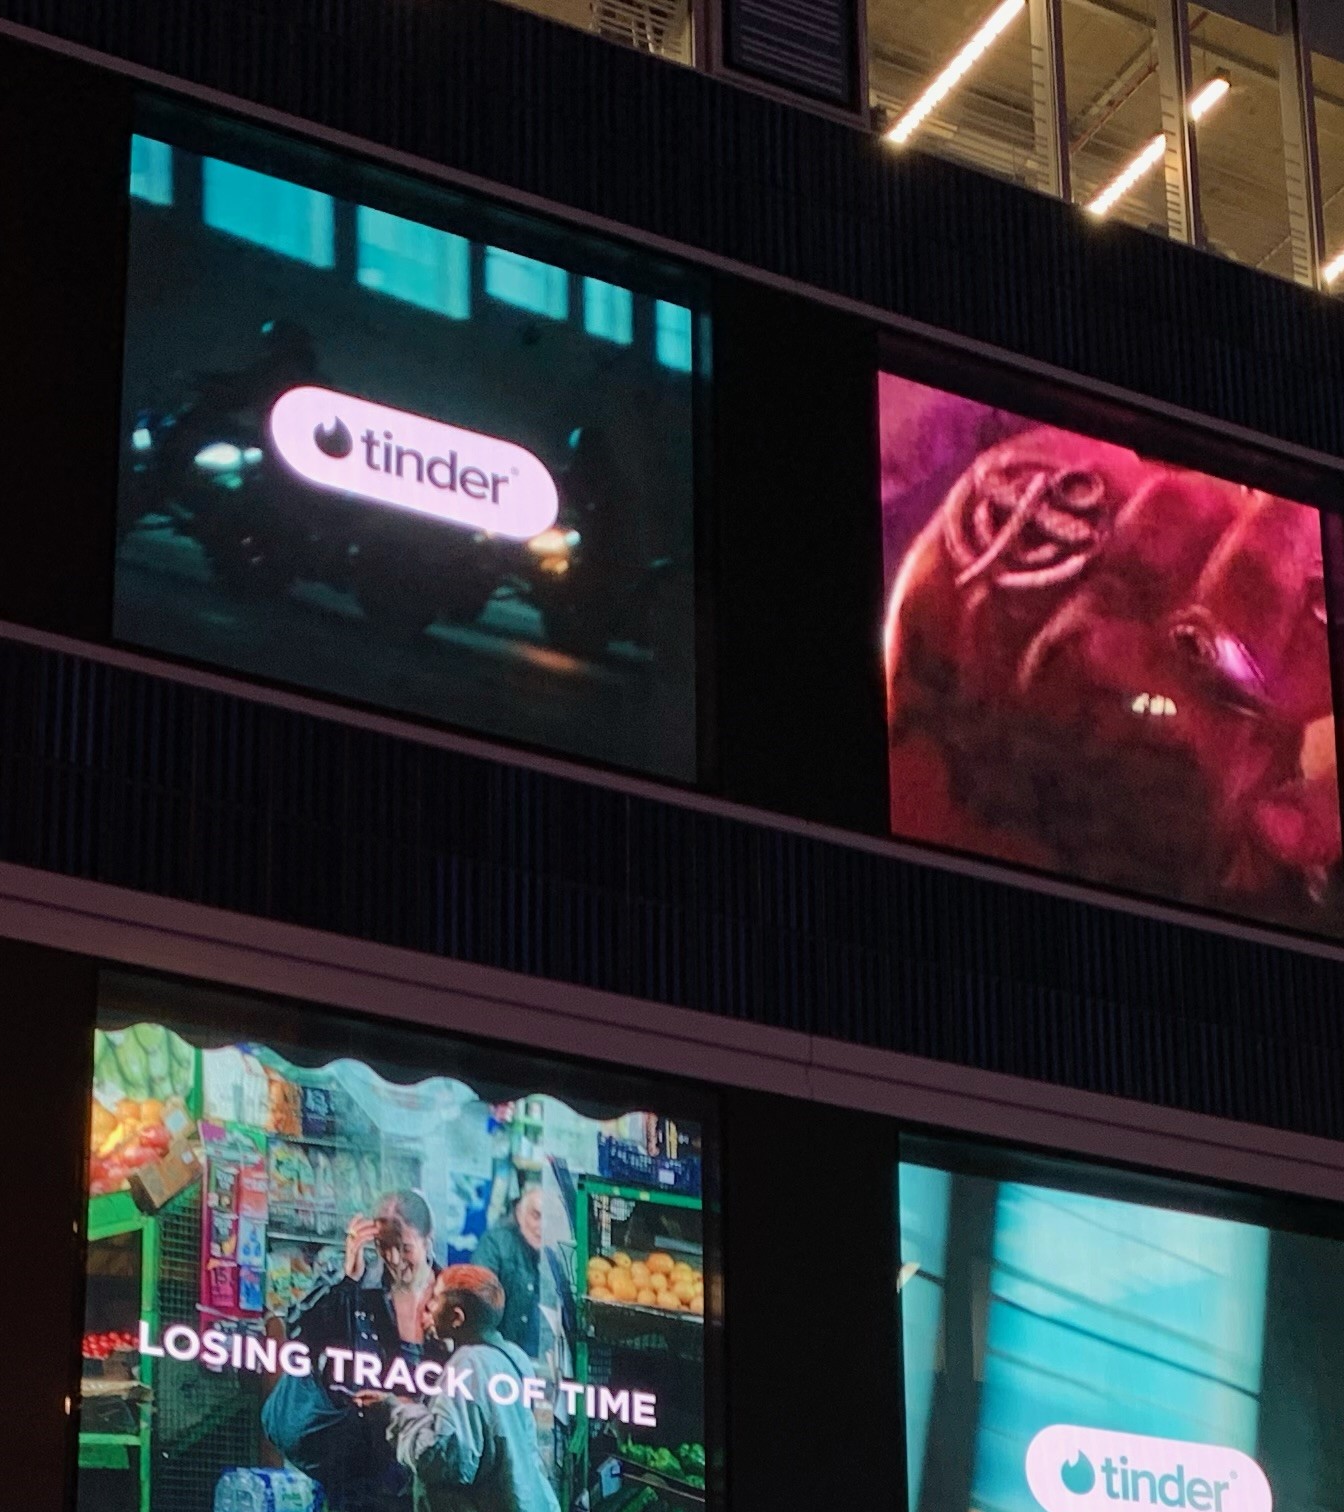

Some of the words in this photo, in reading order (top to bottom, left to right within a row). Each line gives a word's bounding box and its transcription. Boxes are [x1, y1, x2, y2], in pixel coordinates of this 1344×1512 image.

[138, 1319, 311, 1378] LOSING
[325, 1346, 474, 1400] TRACK
[488, 1372, 546, 1409] OF
[559, 1380, 657, 1428] TIME
